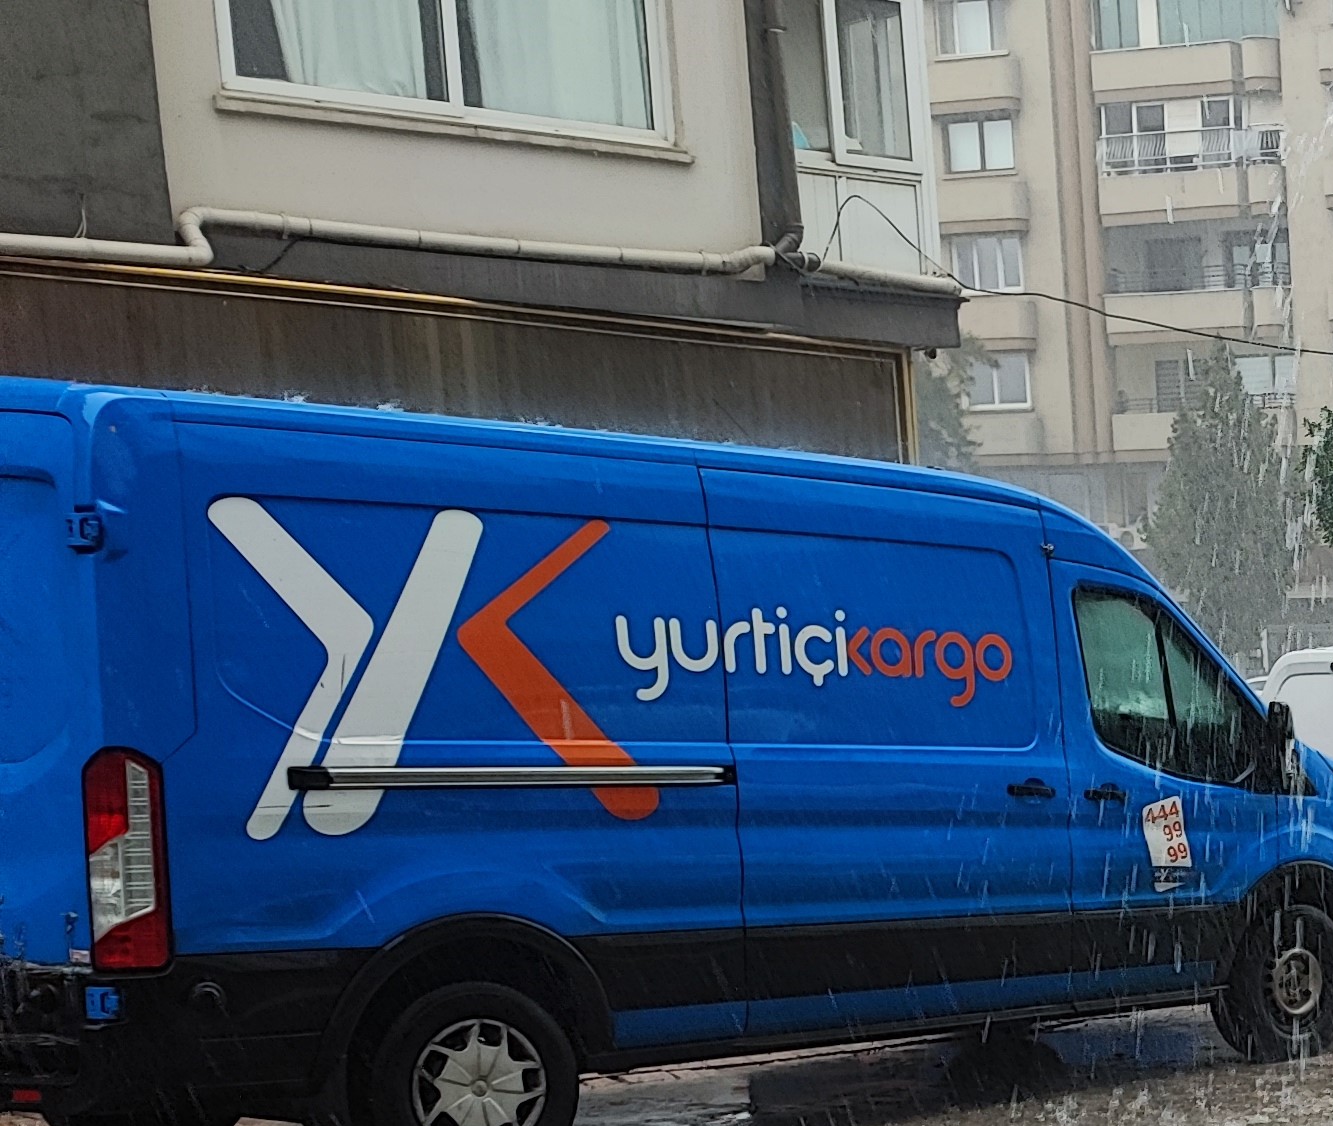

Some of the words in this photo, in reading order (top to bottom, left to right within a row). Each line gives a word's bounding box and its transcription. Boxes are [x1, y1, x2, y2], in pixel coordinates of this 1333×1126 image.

[1145, 801, 1180, 824] 444
[1163, 821, 1183, 842] 99
[1167, 842, 1188, 863] 99
